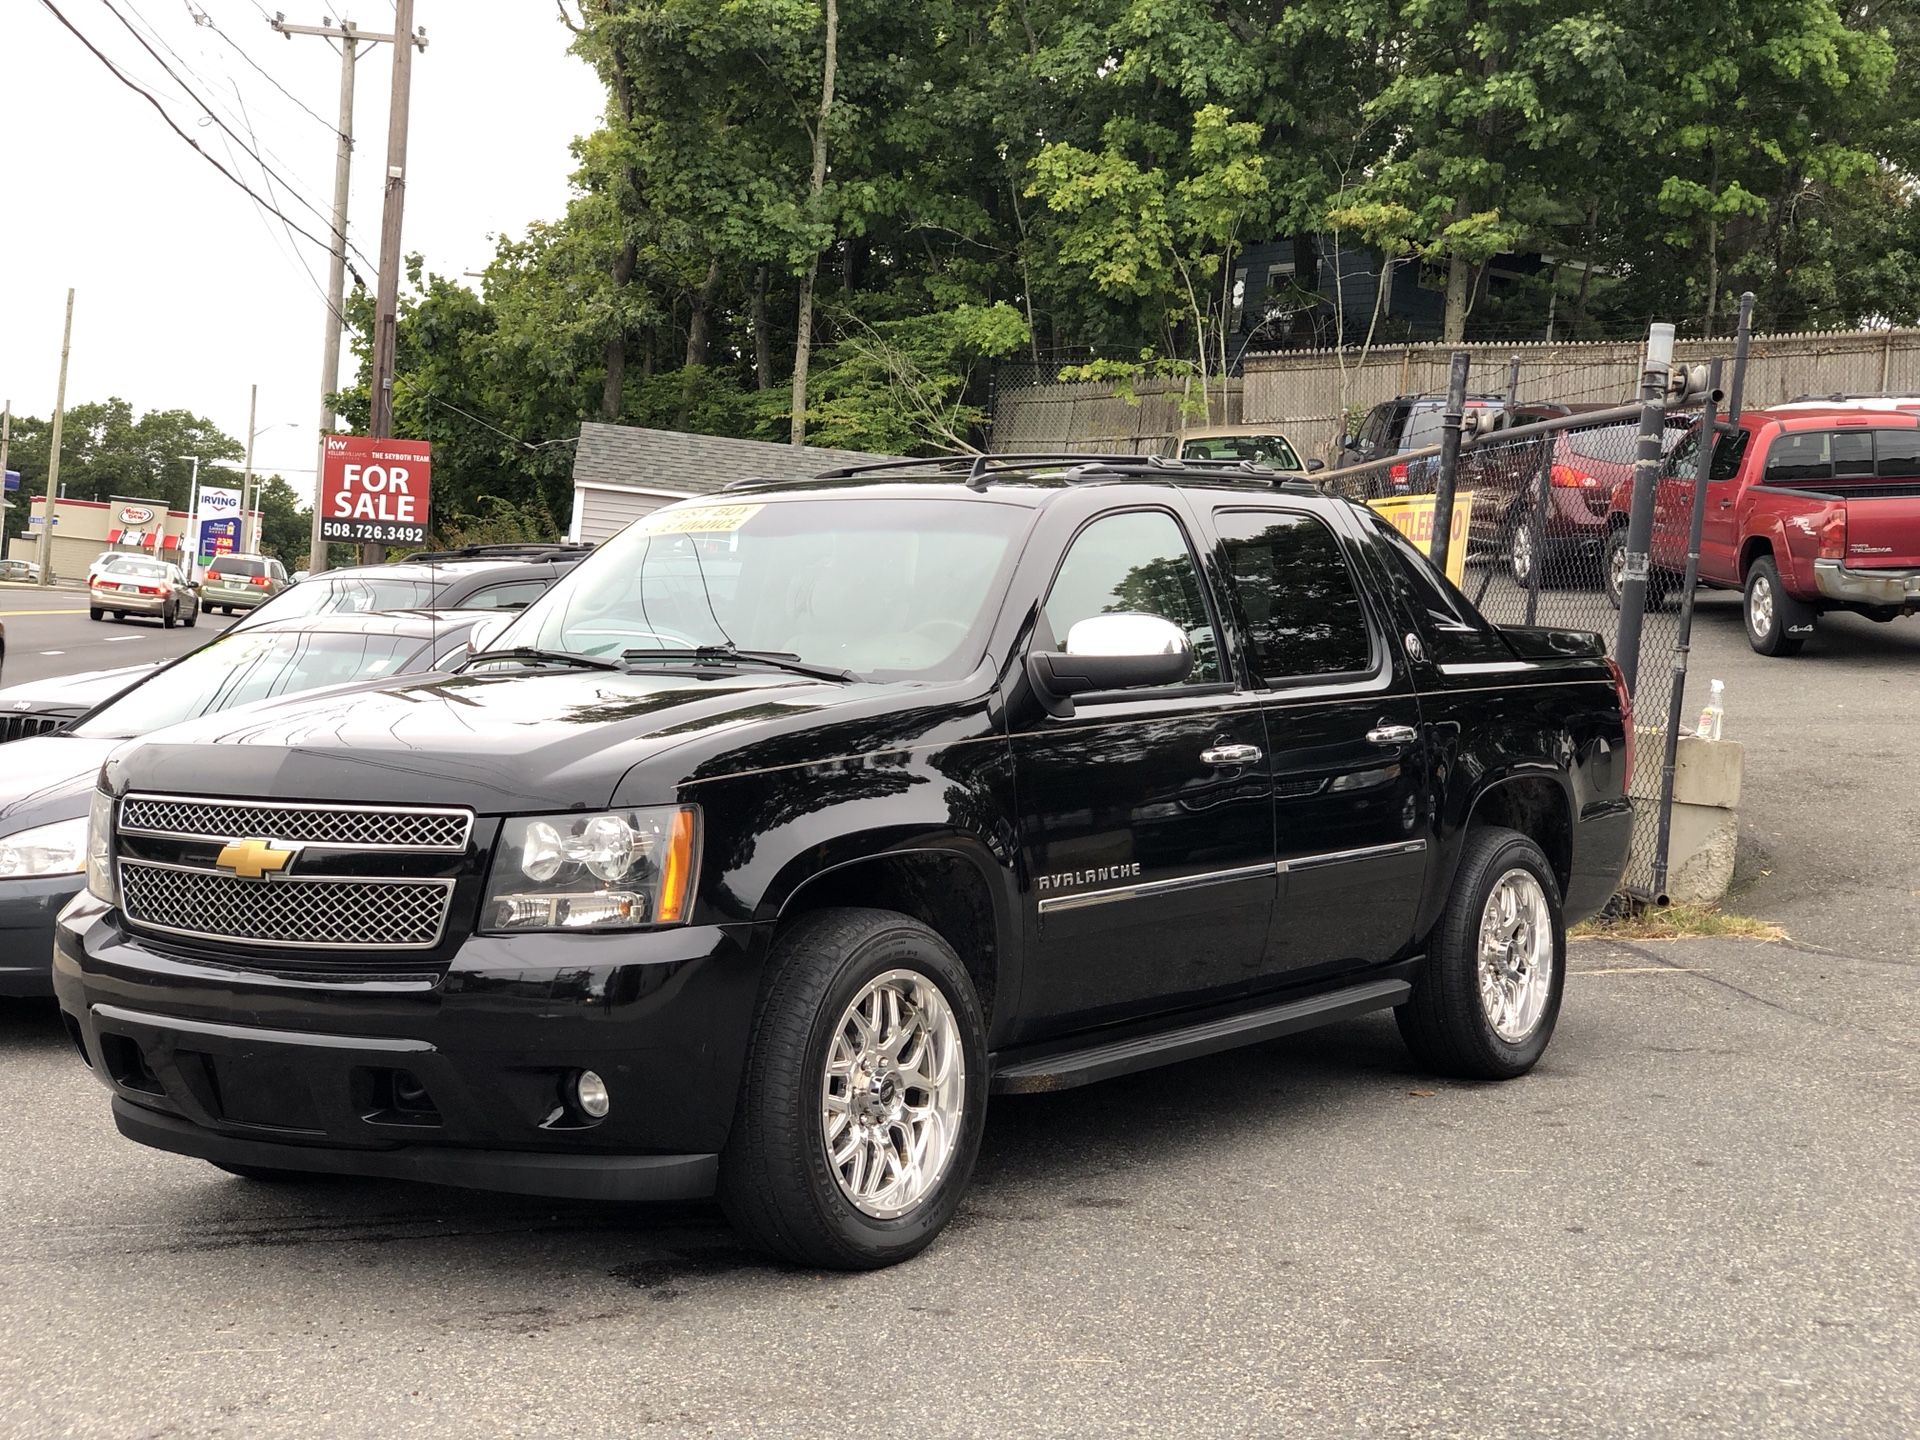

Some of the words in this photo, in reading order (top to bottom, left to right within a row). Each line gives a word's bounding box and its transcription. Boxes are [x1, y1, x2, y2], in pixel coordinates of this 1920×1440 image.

[328, 437, 347, 450] kw
[413, 455, 429, 463] TEAM
[343, 464, 410, 494] FOR
[201, 495, 237, 507] IRVING
[334, 491, 415, 521] SALE
[323, 522, 423, 542] 508.726.3492
[1390, 508, 1463, 541] TTLEBO
[1039, 862, 1141, 890] AVALANCHE
